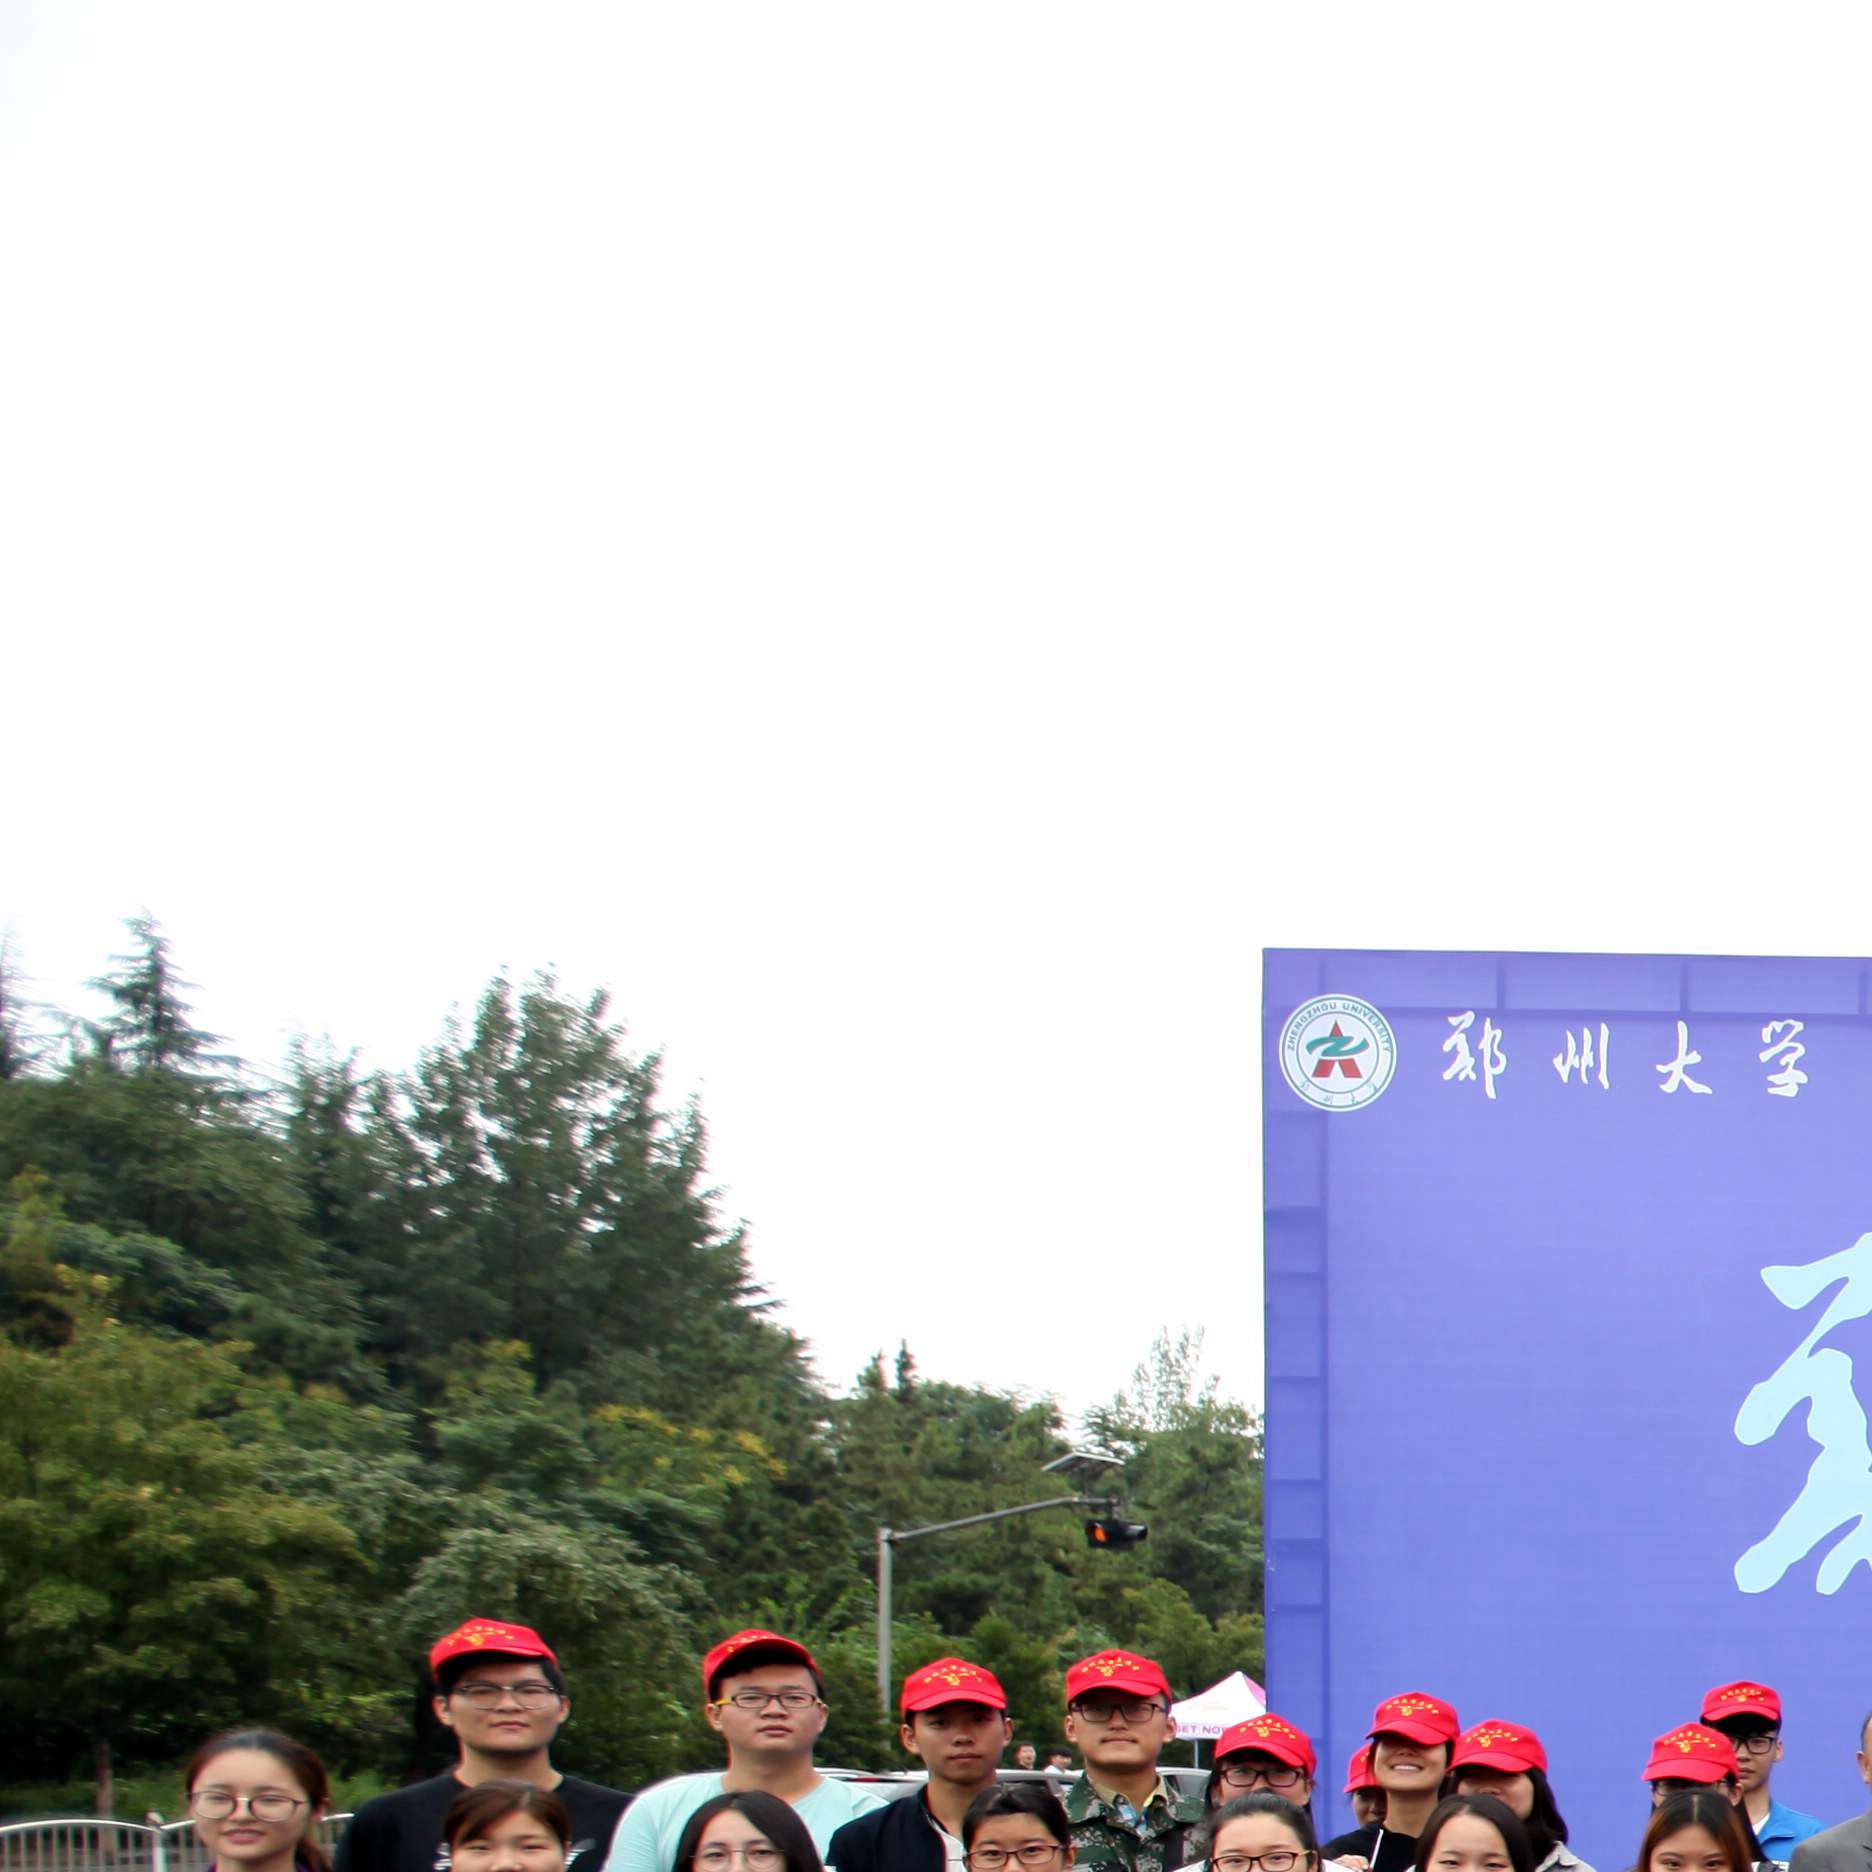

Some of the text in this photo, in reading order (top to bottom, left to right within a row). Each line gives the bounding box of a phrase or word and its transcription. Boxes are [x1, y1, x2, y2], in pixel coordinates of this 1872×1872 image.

[1286, 1001, 1392, 1053] ZHENGZHOU UNIVERSITY
[1442, 1010, 1809, 1100] 郑州大学
